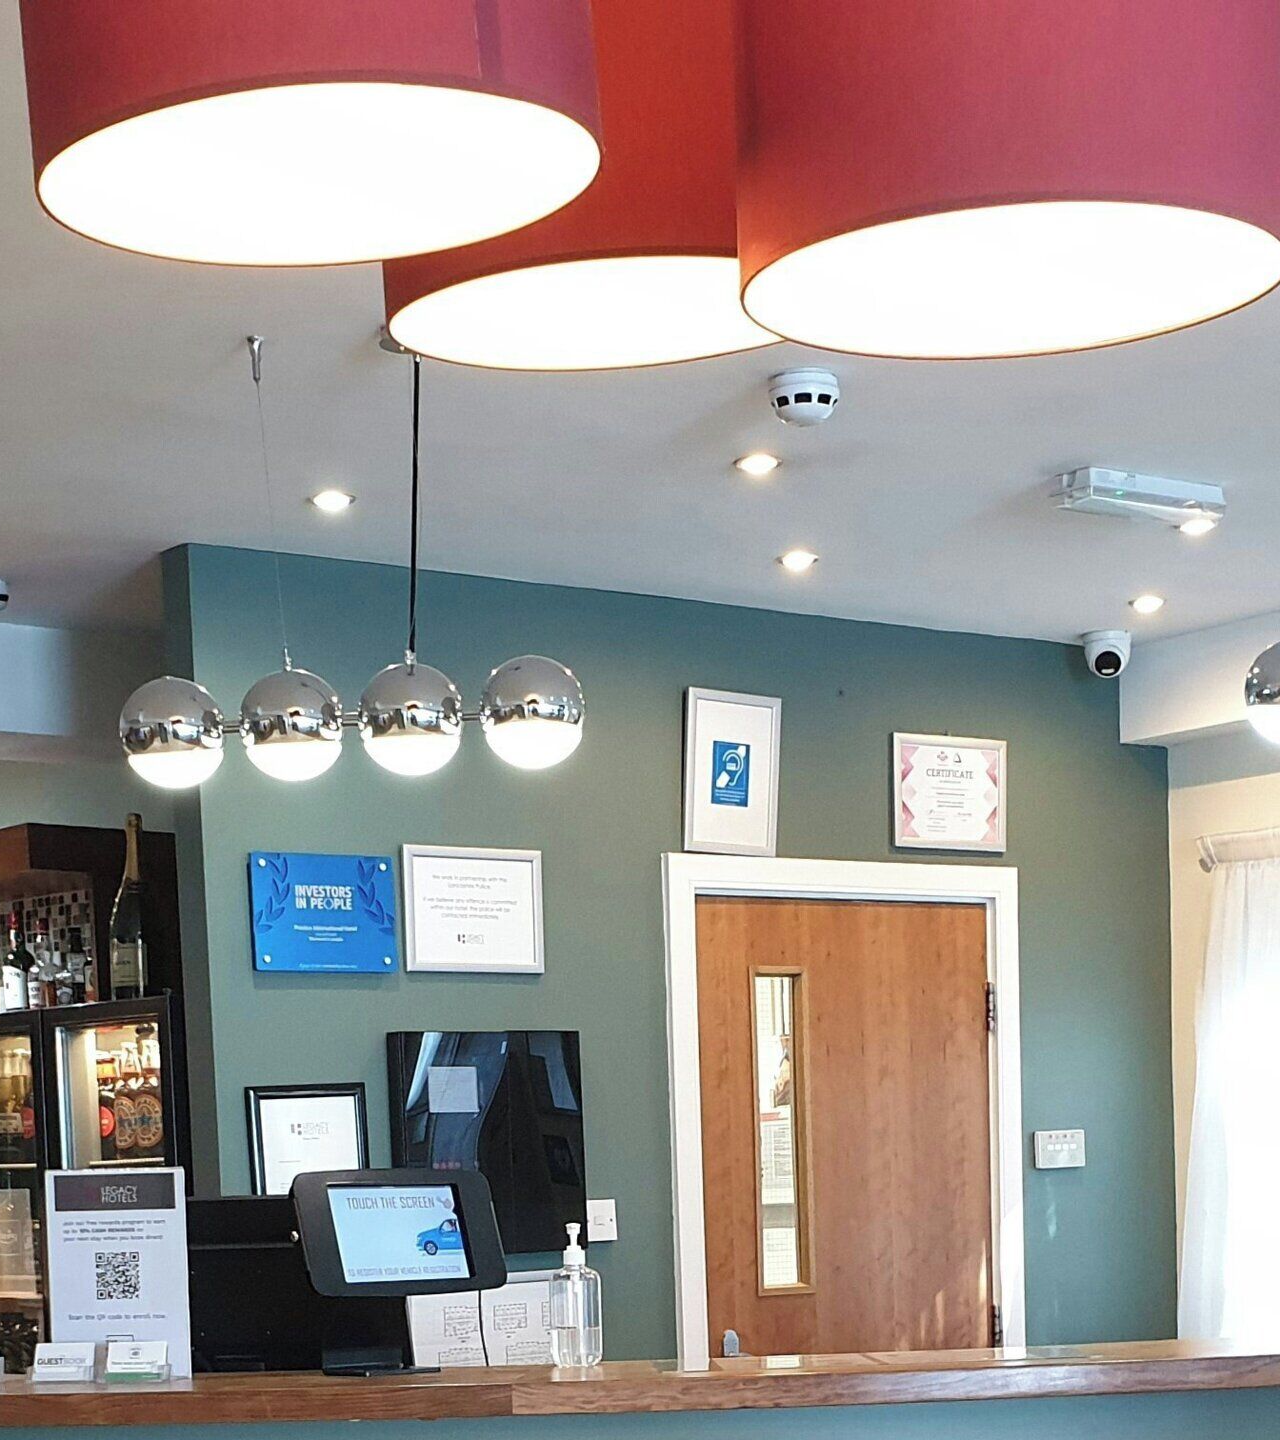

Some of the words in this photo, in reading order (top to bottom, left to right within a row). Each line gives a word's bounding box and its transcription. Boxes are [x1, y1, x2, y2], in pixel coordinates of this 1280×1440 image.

[926, 768, 974, 779] CERTIFICATE
[294, 884, 353, 898] INVESTORS
[295, 897, 307, 909] IN
[310, 897, 353, 910] PEOPLE
[101, 1185, 138, 1195] LEGACY
[101, 1194, 138, 1203] HOTELS
[346, 1196, 378, 1210] TOUCH
[380, 1196, 397, 1209] THE
[400, 1196, 435, 1209] SCREEN
[384, 1267, 399, 1275] YOUR
[423, 1265, 461, 1274] REGISTRATION
[37, 1357, 87, 1366] GUESTBOOK
